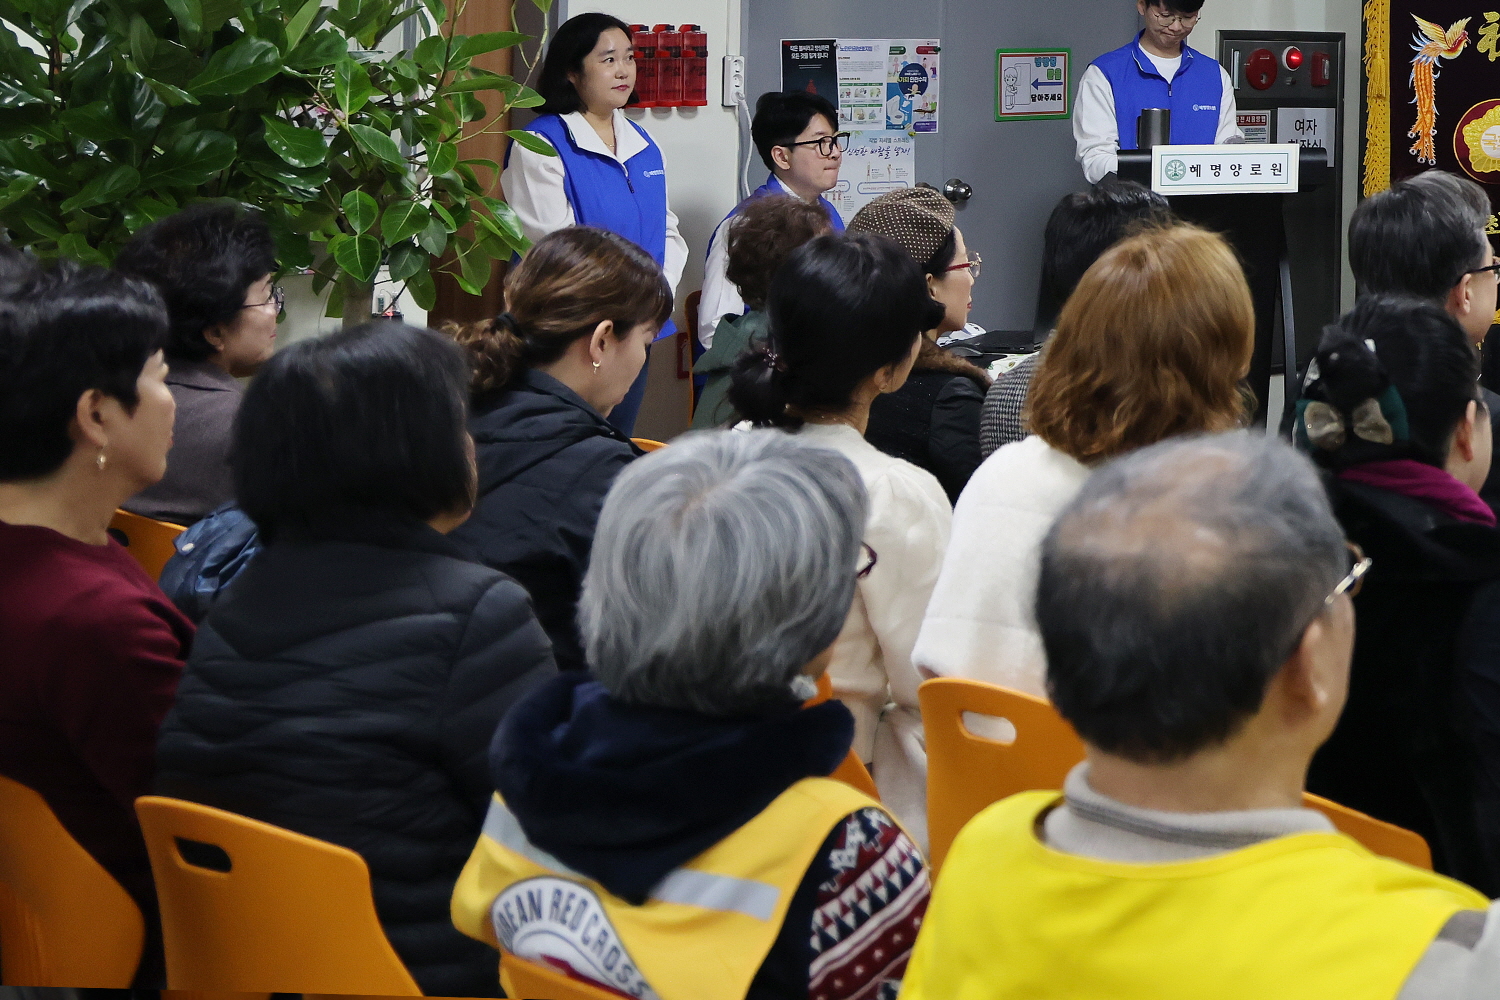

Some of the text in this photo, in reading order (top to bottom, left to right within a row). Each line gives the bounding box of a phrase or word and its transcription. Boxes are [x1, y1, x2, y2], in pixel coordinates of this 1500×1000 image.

[1031, 93, 1062, 103] 닫아주세요
[1294, 118, 1318, 136] 여자
[1189, 162, 1282, 178] 혜명양로원
[548, 887, 589, 933] RED
